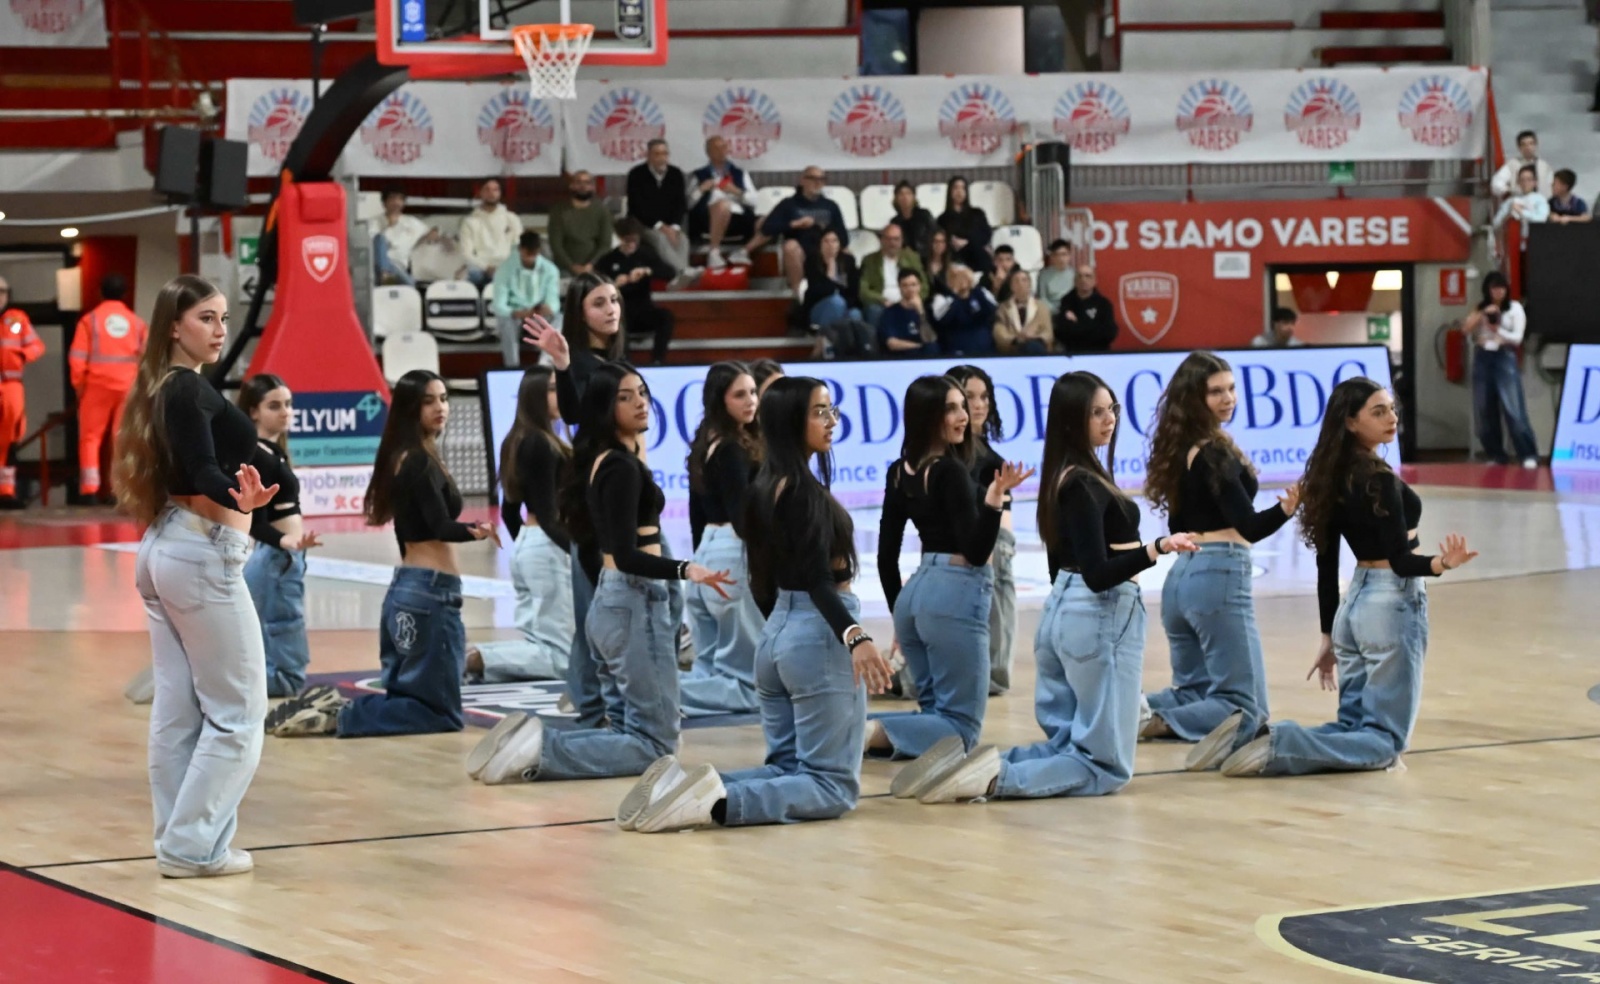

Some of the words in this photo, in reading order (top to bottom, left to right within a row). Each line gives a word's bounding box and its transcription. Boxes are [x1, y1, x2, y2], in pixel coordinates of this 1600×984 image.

[1138, 217, 1263, 249] SIAMO
[1271, 216, 1410, 247] VARESE
[288, 407, 357, 433] ELYUM
[1387, 934, 1583, 972] SERIE
